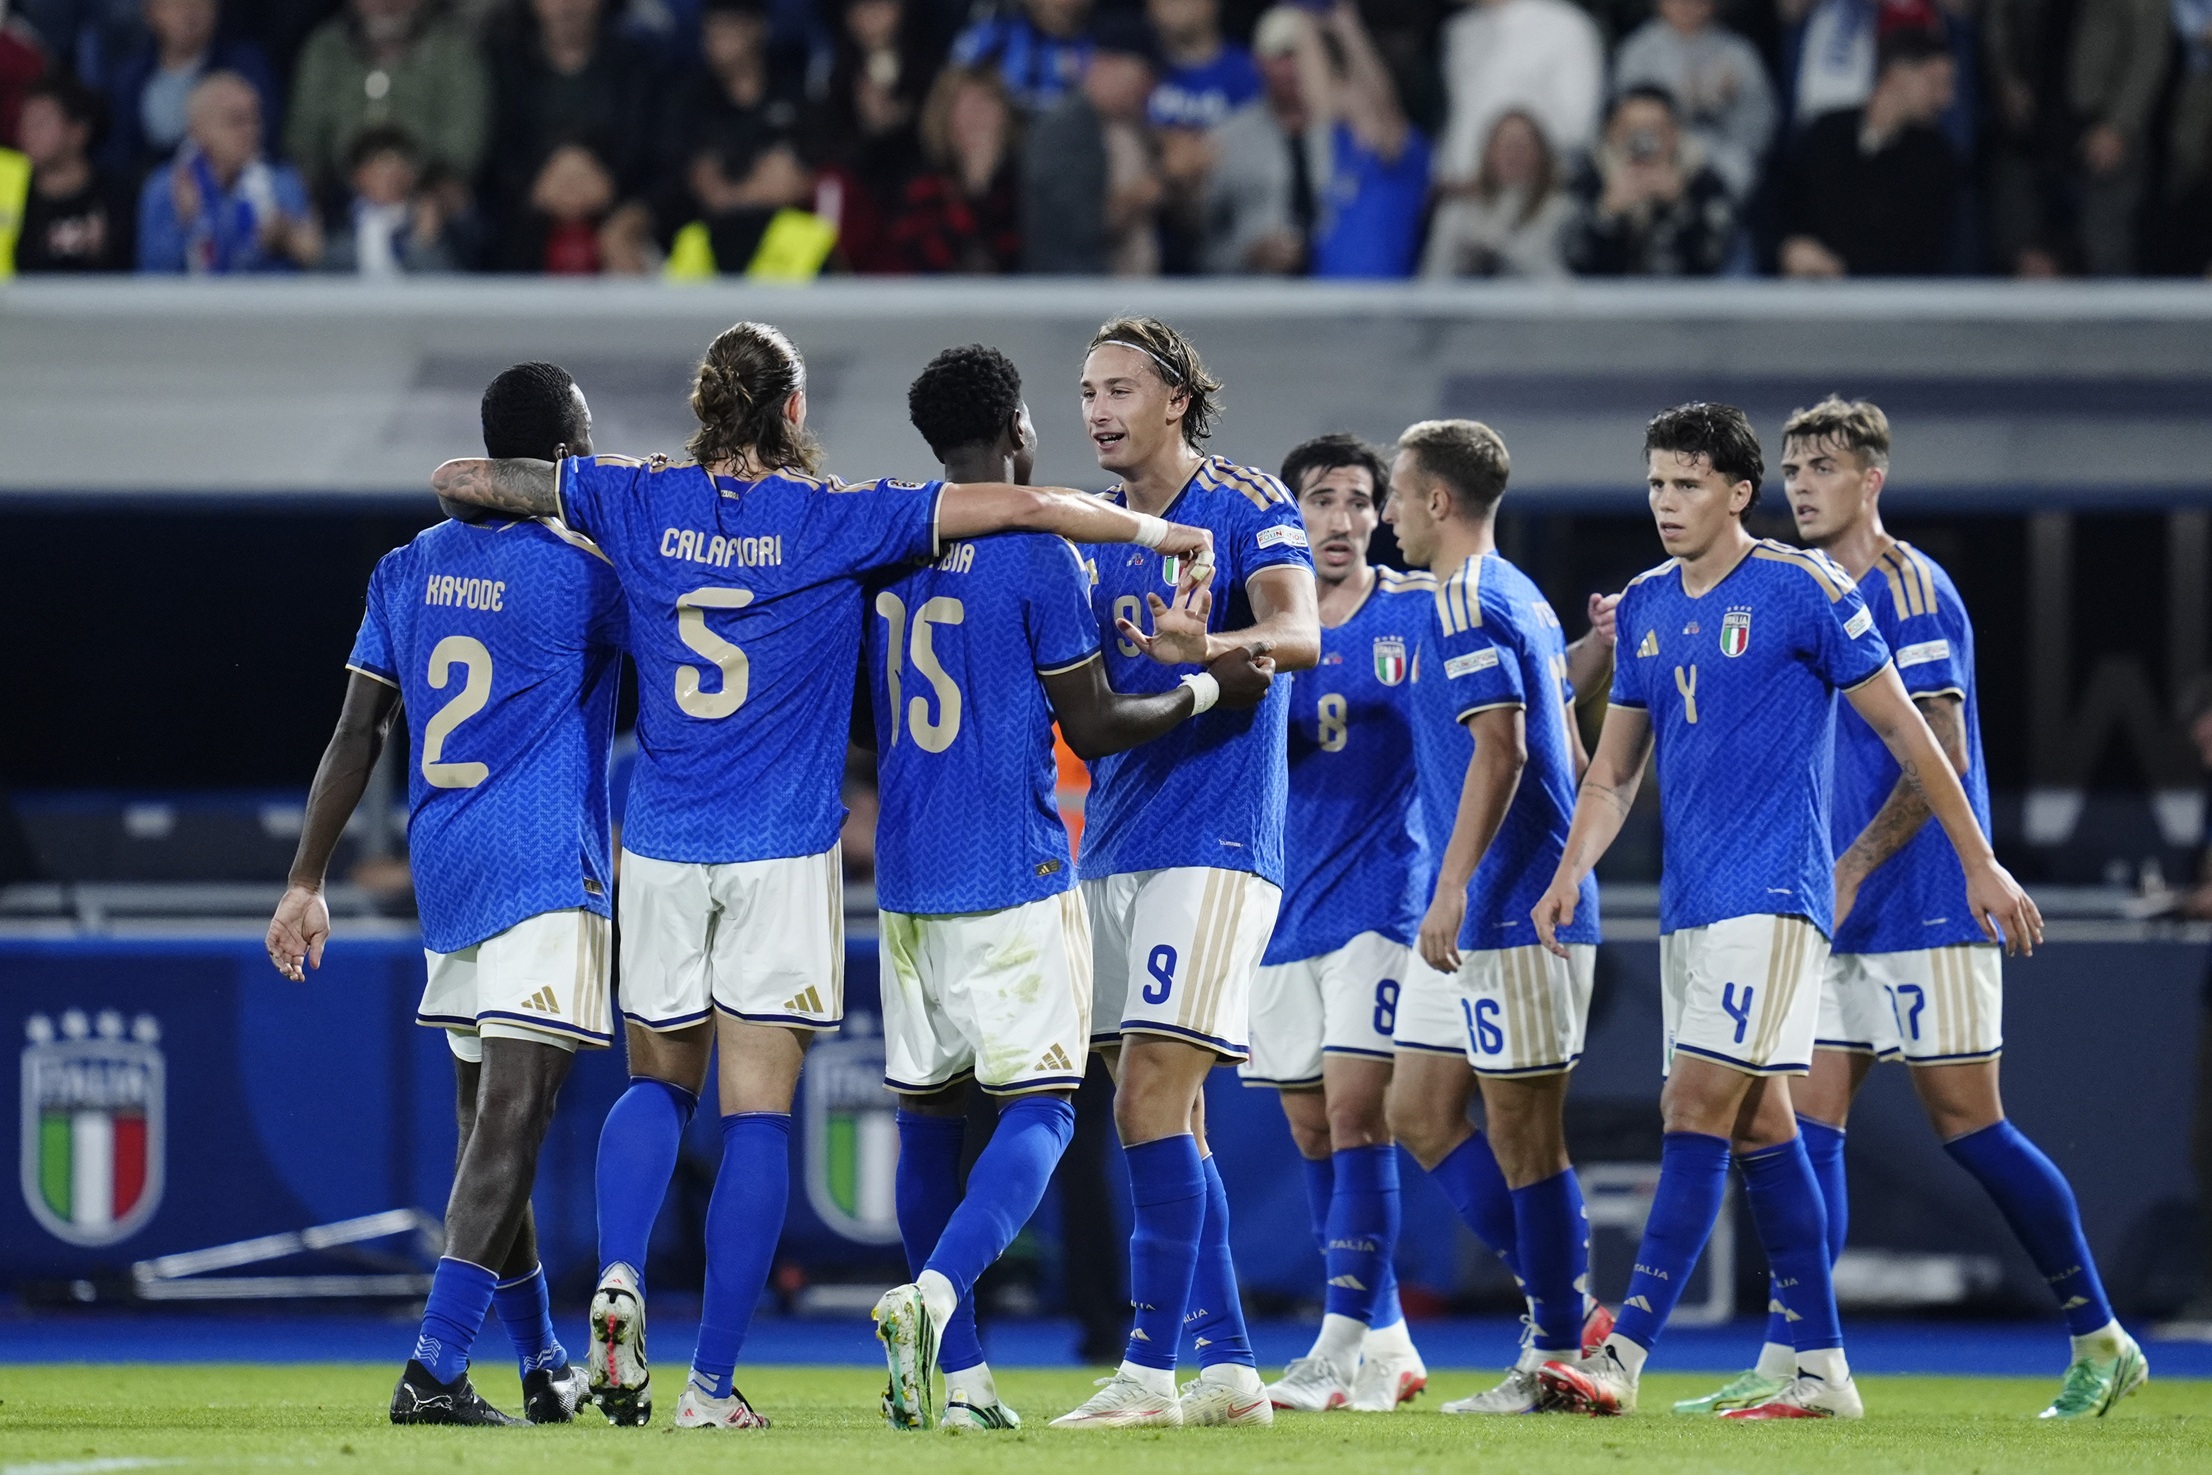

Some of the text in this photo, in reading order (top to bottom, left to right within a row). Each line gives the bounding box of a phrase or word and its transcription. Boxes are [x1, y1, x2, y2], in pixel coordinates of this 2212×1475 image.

[660, 527, 782, 567] CALAFIORI
[425, 574, 506, 612] KAYODE
[674, 586, 755, 719] 5
[875, 591, 965, 754] 15
[421, 635, 493, 788] 2
[1318, 692, 1347, 752] 8
[1674, 664, 1698, 724] 4
[1142, 943, 1178, 1005] 9
[1374, 978, 1400, 1035] 8
[1461, 998, 1503, 1055] 16
[1722, 981, 1754, 1044] 4
[1183, 1308, 1208, 1324] ALIA
